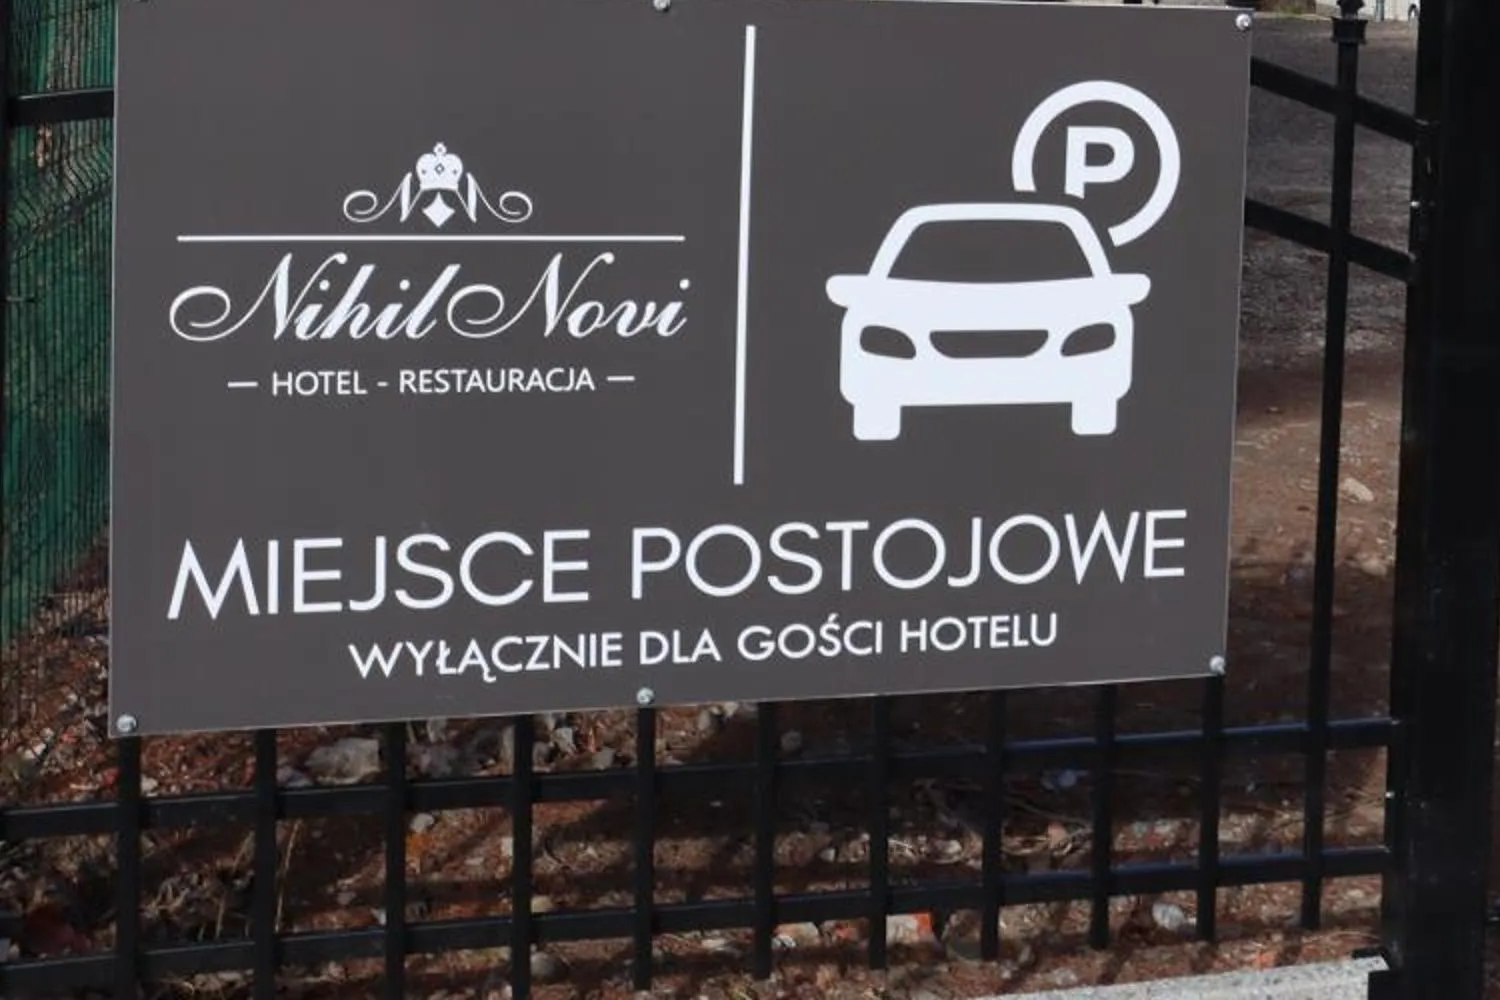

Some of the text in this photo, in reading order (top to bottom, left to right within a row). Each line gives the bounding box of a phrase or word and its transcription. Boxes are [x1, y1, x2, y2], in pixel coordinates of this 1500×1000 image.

[1064, 125, 1135, 199] P
[169, 251, 691, 342] Nihil Novi
[272, 370, 368, 396] HOTEL
[399, 367, 596, 394] RESTAURACJA
[167, 509, 1188, 620] MIEJSCE POSTOJOWE
[347, 612, 1058, 683] WYŁĄCZNIE DLA GOŚCI HOTELU
